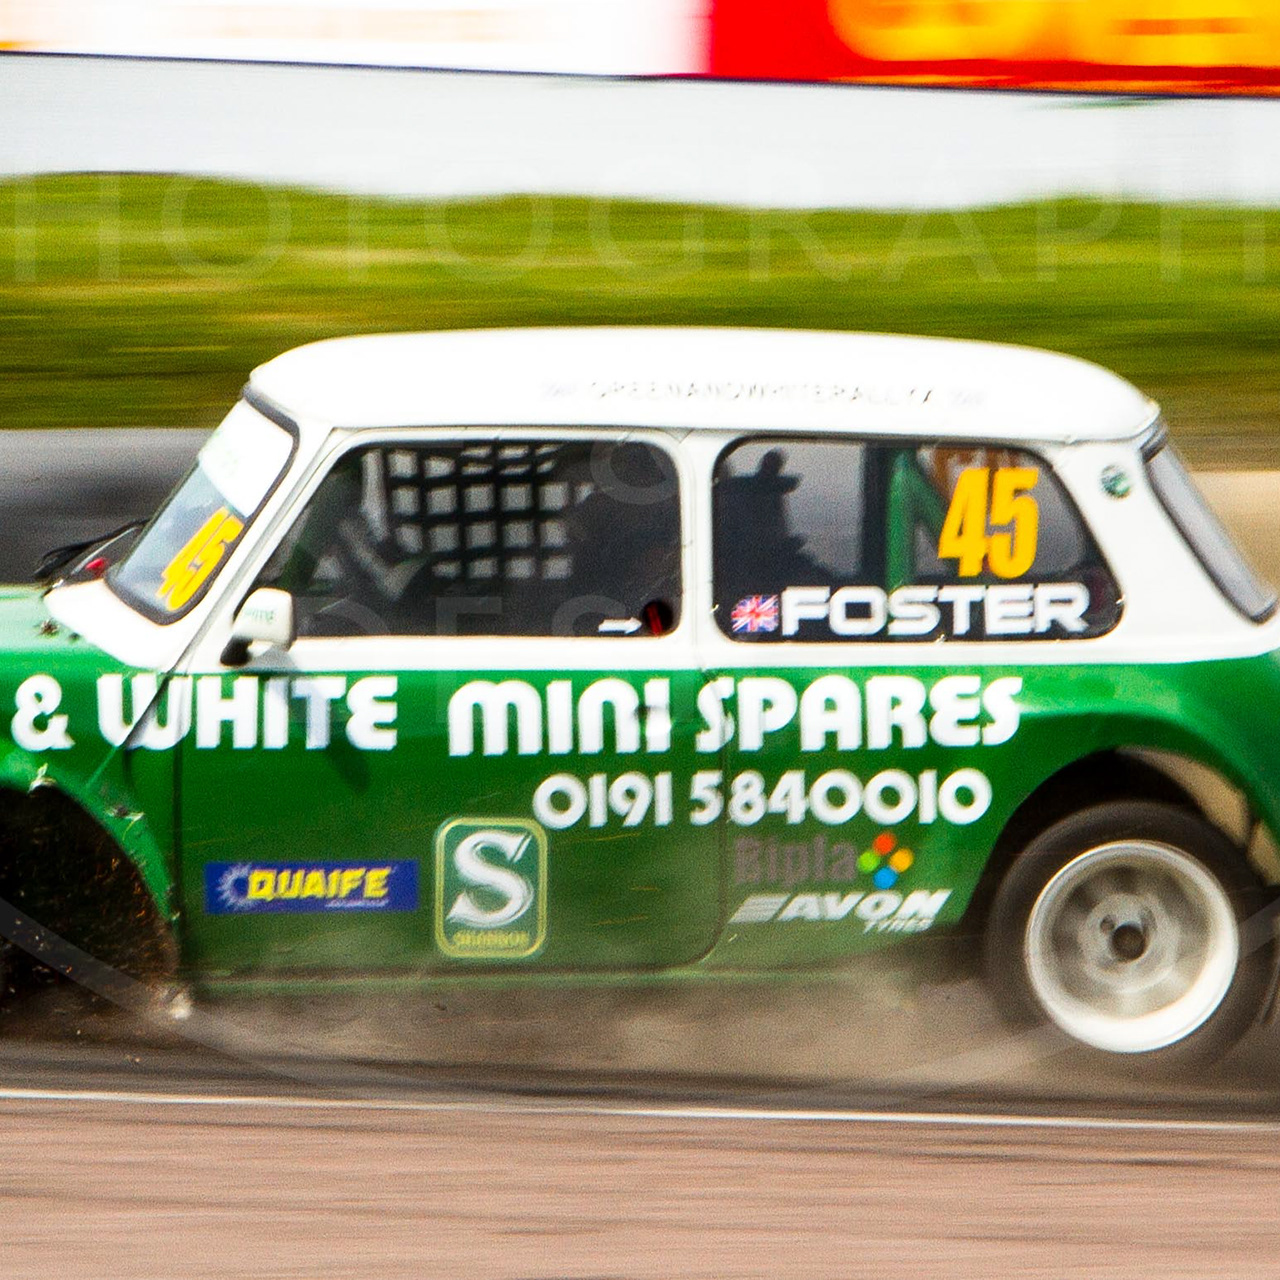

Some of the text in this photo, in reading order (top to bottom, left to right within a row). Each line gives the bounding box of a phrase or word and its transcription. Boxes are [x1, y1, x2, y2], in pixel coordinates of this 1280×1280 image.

[937, 465, 1041, 579] 45
[156, 506, 245, 612] 45
[780, 582, 1090, 636] FOSTER
[11, 673, 73, 751] &
[96, 672, 399, 751] WHITE
[448, 677, 673, 756] MINI
[695, 673, 1023, 753] SPARES
[532, 767, 992, 829] 0191 5840010
[246, 867, 391, 901] QUAIFE
[777, 888, 953, 922] AVON
